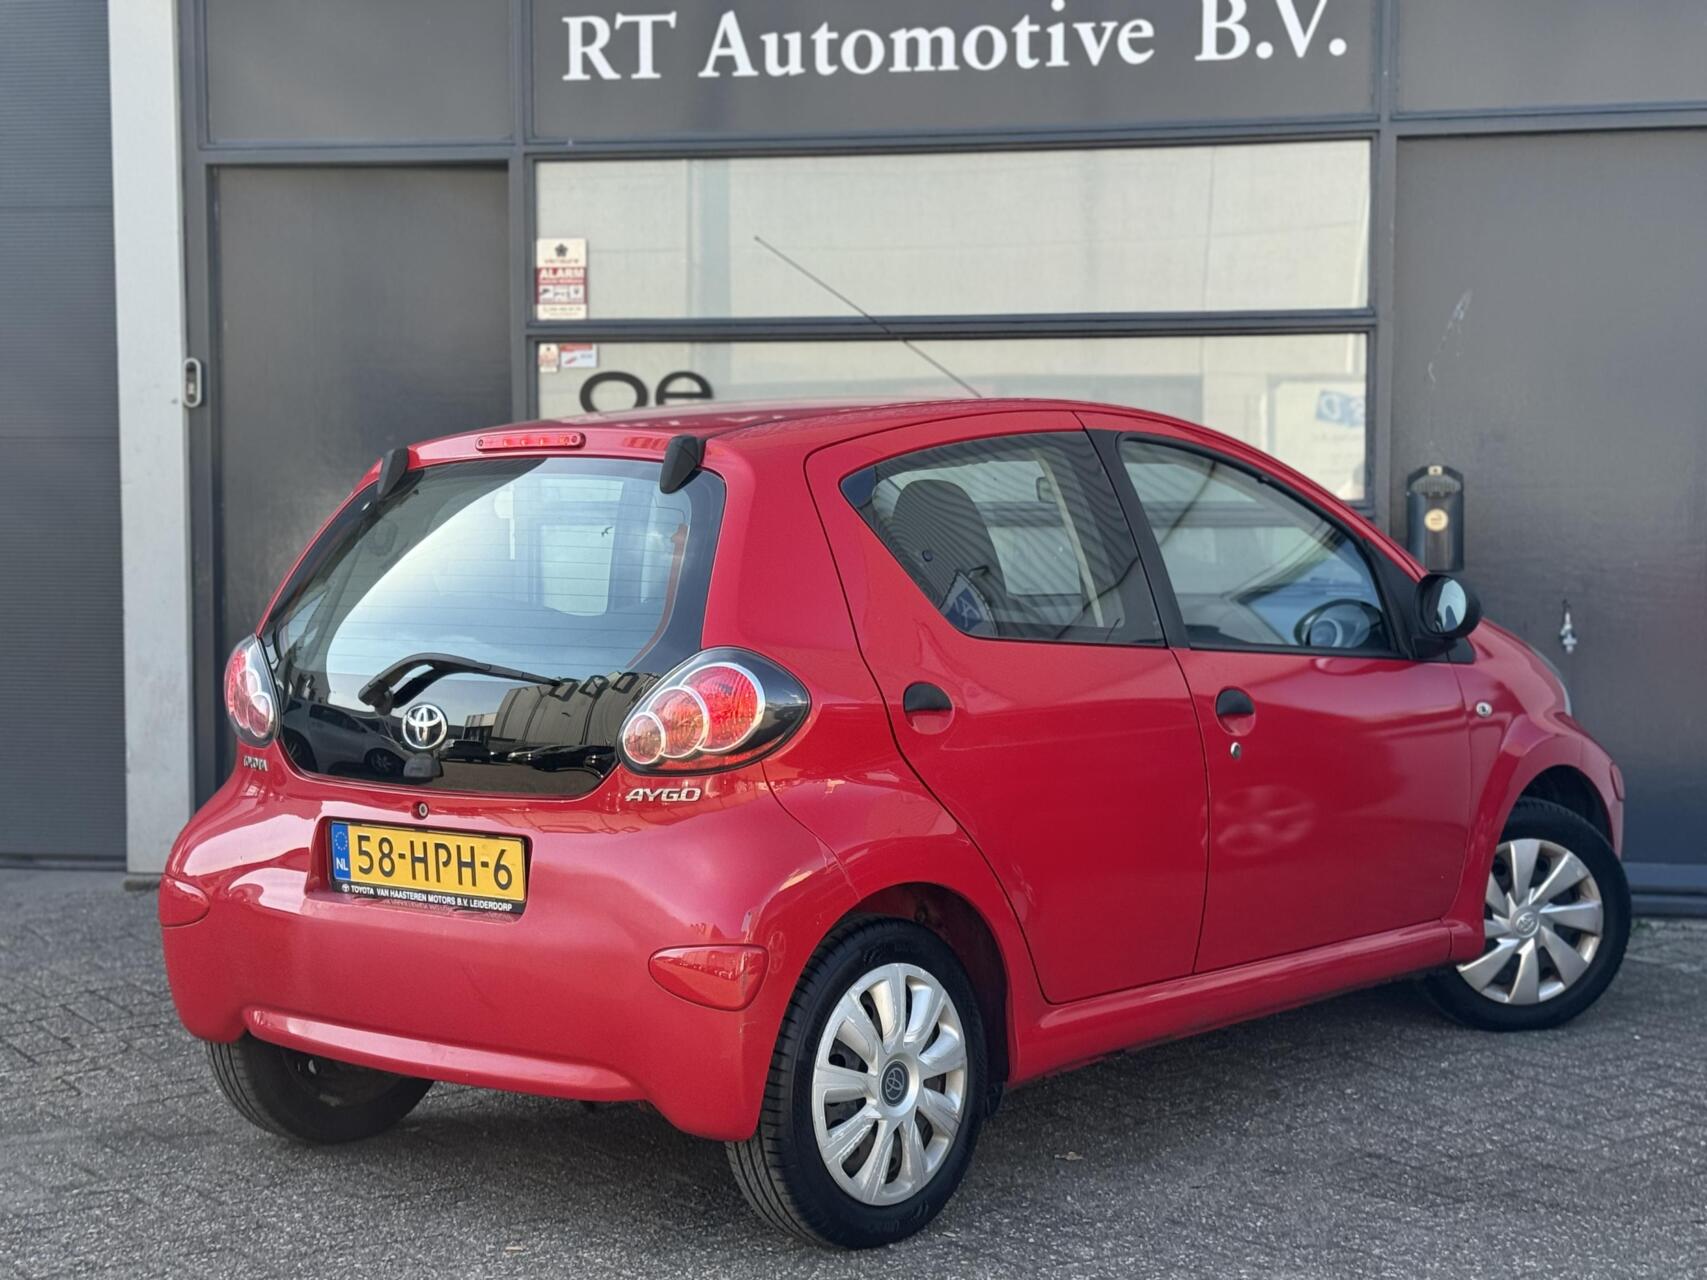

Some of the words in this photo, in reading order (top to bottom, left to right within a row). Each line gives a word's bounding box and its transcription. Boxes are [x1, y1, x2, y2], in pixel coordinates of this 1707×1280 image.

[562, 11, 677, 81] RT
[697, 0, 1155, 79] Automotive
[1194, 0, 1347, 62] B.V.
[538, 267, 585, 279] ALARM
[625, 787, 701, 802] AYGO
[336, 857, 349, 872] NL
[356, 834, 513, 891] 58-HPH-6
[351, 885, 375, 896] TOYOTA
[376, 887, 389, 898] VAN
[389, 889, 427, 902] HAASTEREN
[428, 894, 456, 906] MOTORS
[457, 897, 468, 907] B.V.
[469, 899, 513, 912] LEIDERDORP
